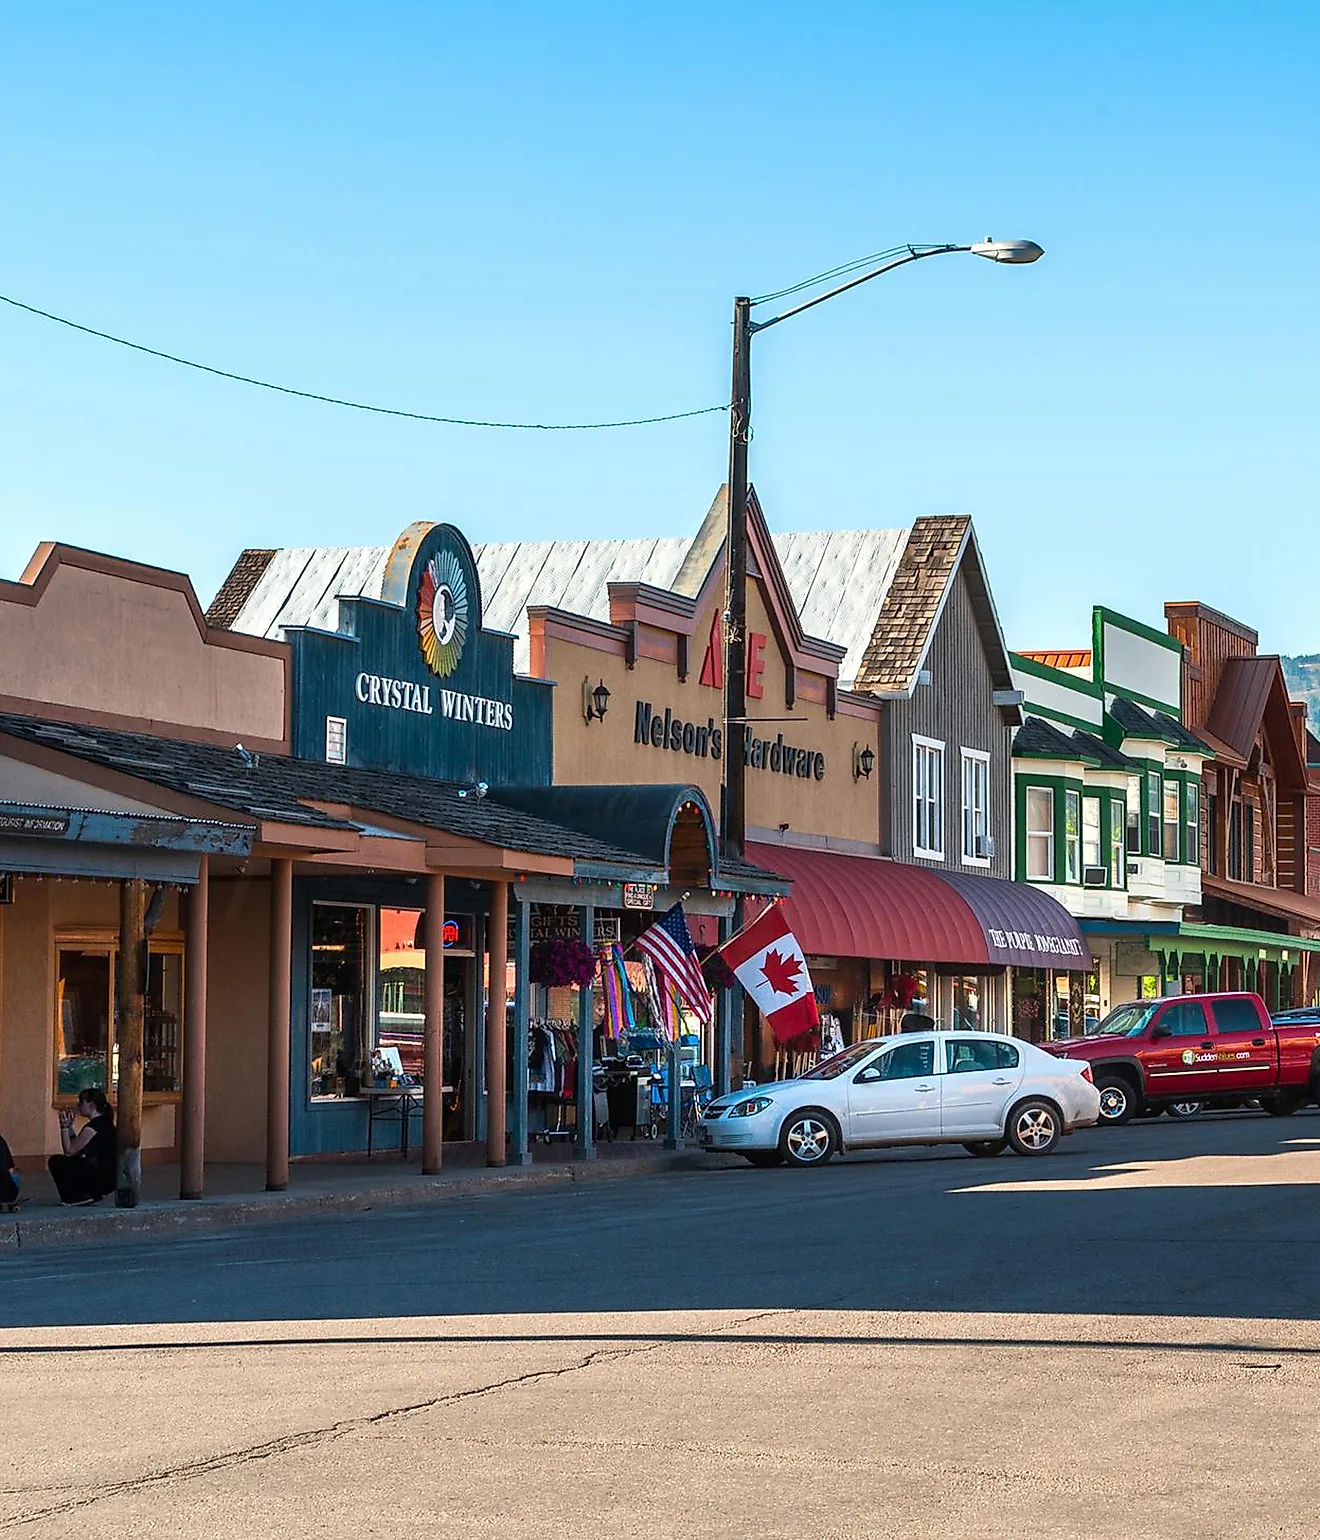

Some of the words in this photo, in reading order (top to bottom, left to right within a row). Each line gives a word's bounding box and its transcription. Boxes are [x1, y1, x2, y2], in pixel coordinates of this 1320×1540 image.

[698, 608, 768, 700] AE
[355, 672, 434, 715] CRYSTAL
[439, 689, 514, 732] WINTERS
[634, 700, 722, 760] Nelson's
[530, 915, 580, 928] GIFTS
